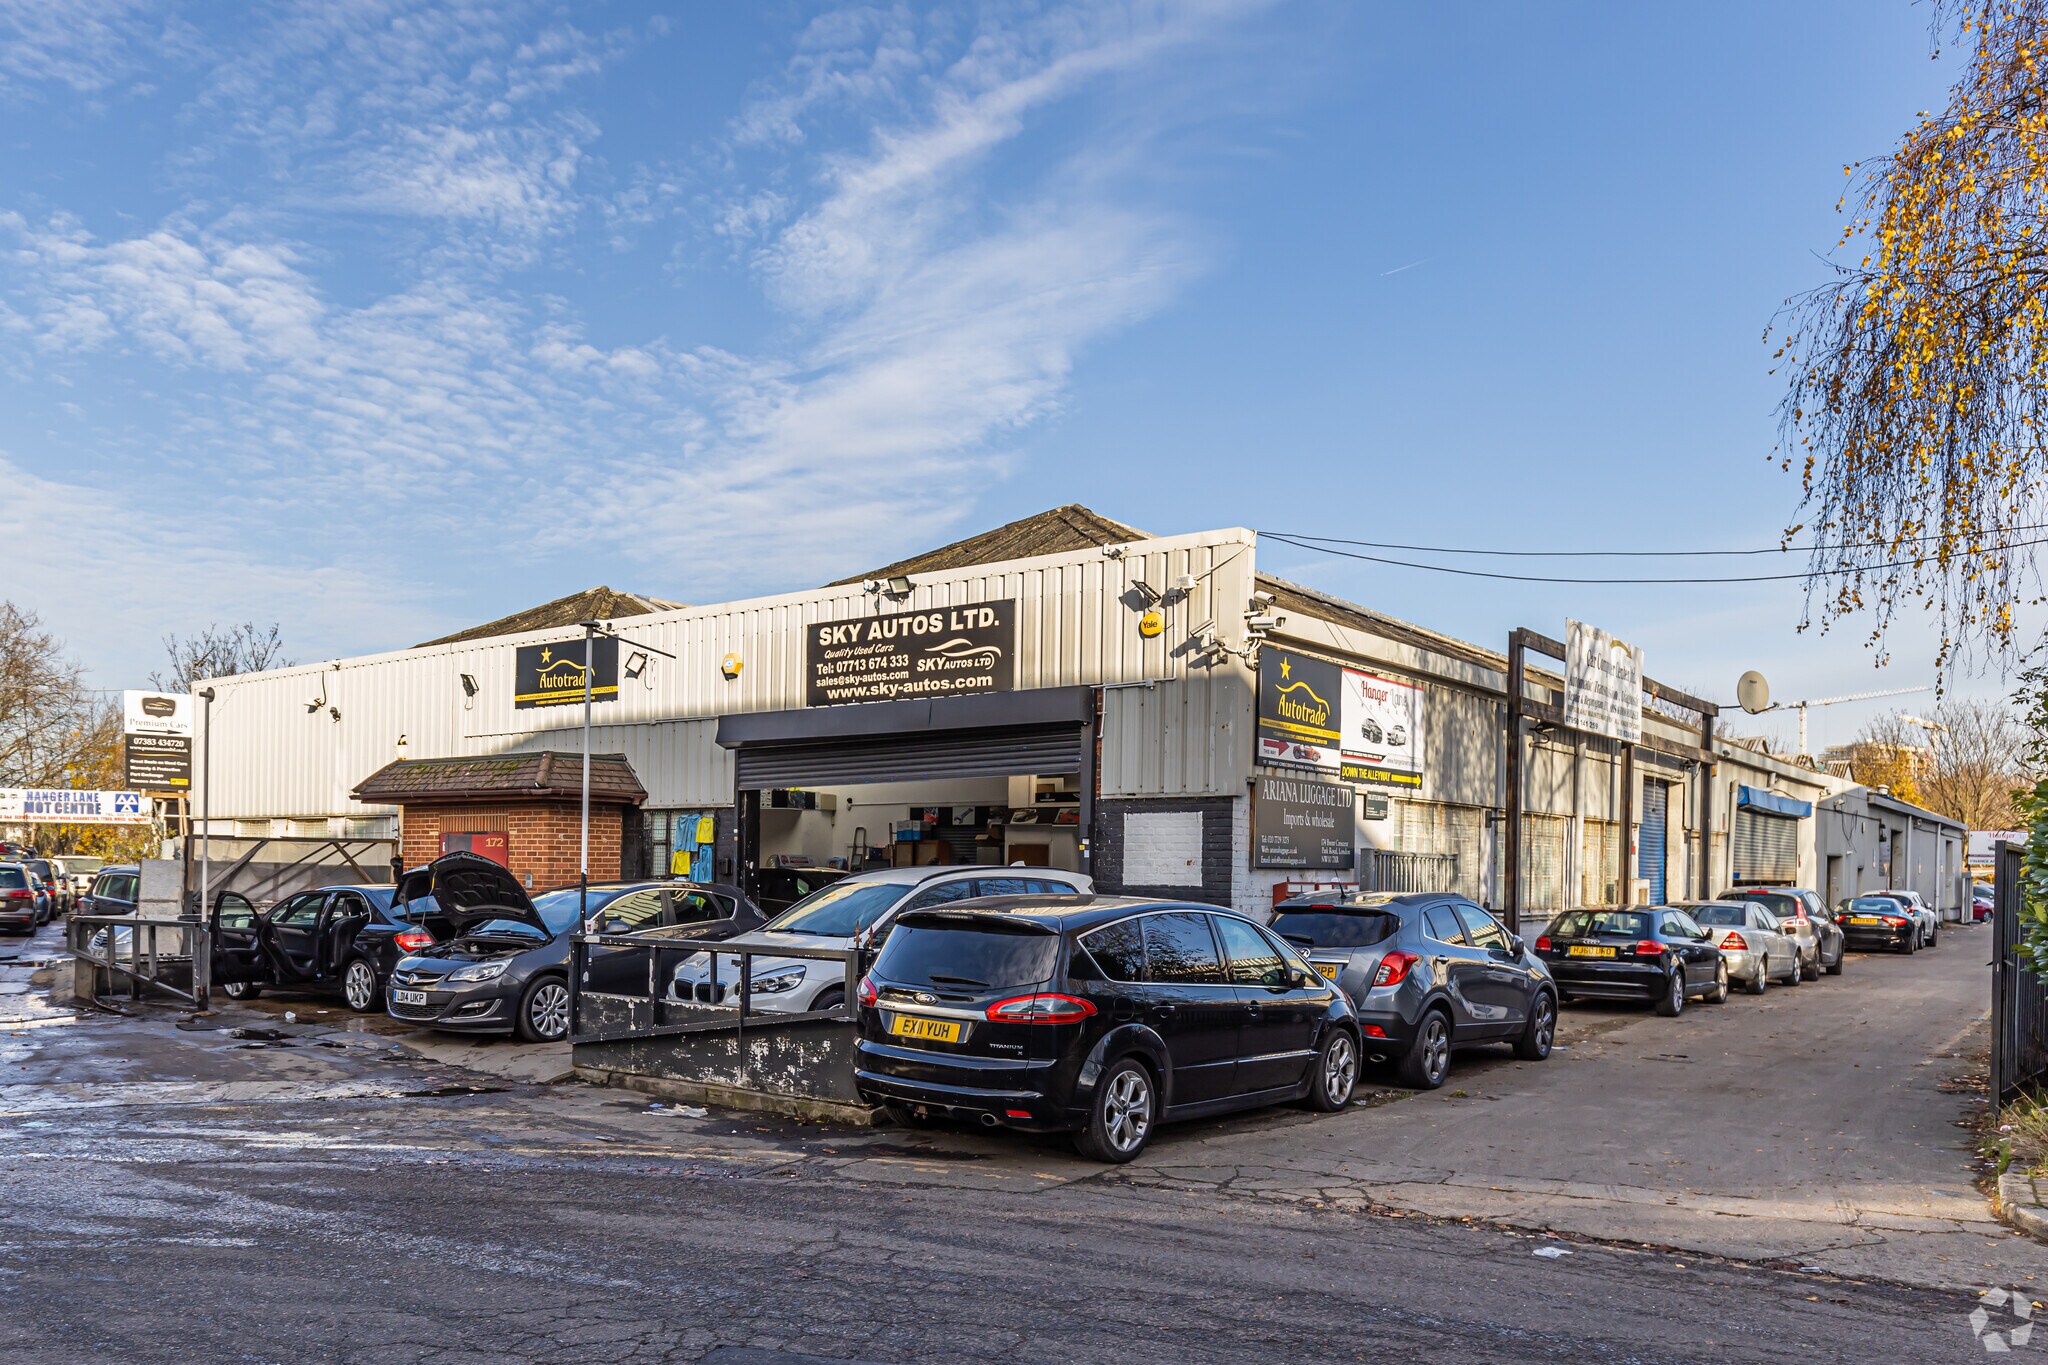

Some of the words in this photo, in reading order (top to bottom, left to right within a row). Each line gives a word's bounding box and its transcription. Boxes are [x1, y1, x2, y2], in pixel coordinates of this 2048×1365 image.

[819, 623, 862, 646] SKY
[867, 613, 943, 641] AUTOS
[950, 607, 1000, 631] LTD.
[1142, 620, 1158, 629] Yale
[824, 646, 853, 659] Quality
[854, 645, 874, 656] Used
[875, 643, 895, 653] Cars
[1587, 649, 1597, 668] Car
[816, 662, 835, 675] Tel:
[836, 658, 867, 673] 07713
[868, 656, 887, 670] 674
[889, 654, 909, 668] 333
[974, 657, 992, 667] LTD
[539, 670, 587, 689] Autotrad
[815, 671, 909, 688] sales@sky-autos.com
[826, 675, 993, 700] www.sky-autos.com
[1361, 680, 1388, 705] Hanger
[1277, 693, 1327, 727] Autotrade
[129, 718, 168, 727] Premium
[170, 720, 188, 729] Cars
[1589, 721, 1599, 730] 259
[133, 737, 156, 746] 07383
[157, 739, 185, 748] 434720
[1342, 766, 1358, 778] DOWN
[1359, 768, 1368, 778] THE
[1367, 769, 1391, 781] ALLEYWAY
[27, 791, 70, 802] HANGER
[73, 792, 99, 803] LANE
[1262, 779, 1298, 803] ARIANA
[1300, 783, 1336, 806] LUGGAGE
[1337, 787, 1352, 808] LTD
[24, 801, 52, 814] MOT
[54, 803, 102, 815] CENTRE
[1283, 808, 1304, 829] Imports
[1305, 810, 1311, 826] &
[1311, 811, 1335, 828] wholesale
[485, 837, 504, 848] 172
[1338, 847, 1350, 855] London
[410, 992, 424, 1003] UKP
[902, 1019, 922, 1034] EX11
[926, 1022, 951, 1039] YUH
